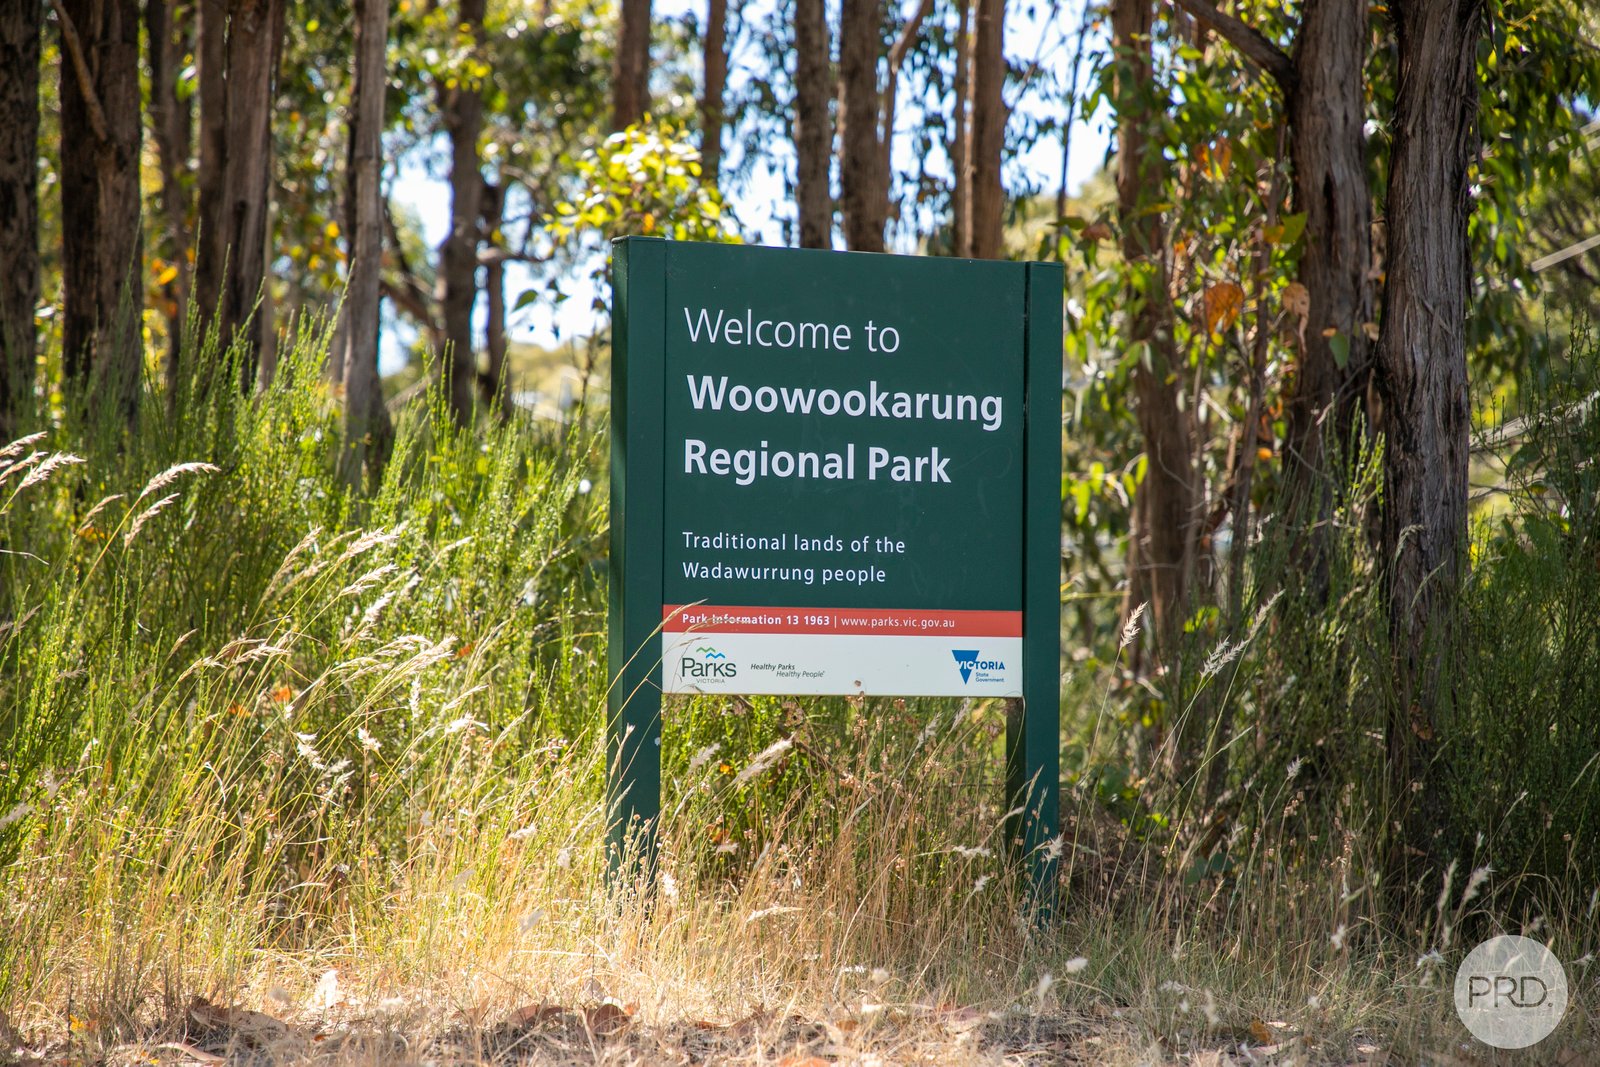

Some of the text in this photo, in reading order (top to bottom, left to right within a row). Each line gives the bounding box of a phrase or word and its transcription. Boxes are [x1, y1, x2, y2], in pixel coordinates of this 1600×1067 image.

[684, 307, 900, 353] Welcome to
[687, 374, 1003, 431] Woowookarung
[684, 439, 952, 485] Regional Park
[682, 532, 906, 553] Traditional lands of the
[682, 562, 886, 585] Wadawurrung people
[682, 613, 708, 624] Park
[786, 615, 799, 625] 13
[803, 615, 830, 626] 1963
[841, 617, 955, 630] www.parks.vic.gov.au
[682, 657, 737, 677] Parks
[750, 663, 777, 672] Healthy
[776, 670, 801, 679] Healthy
[956, 660, 1005, 671] VICTORIA
